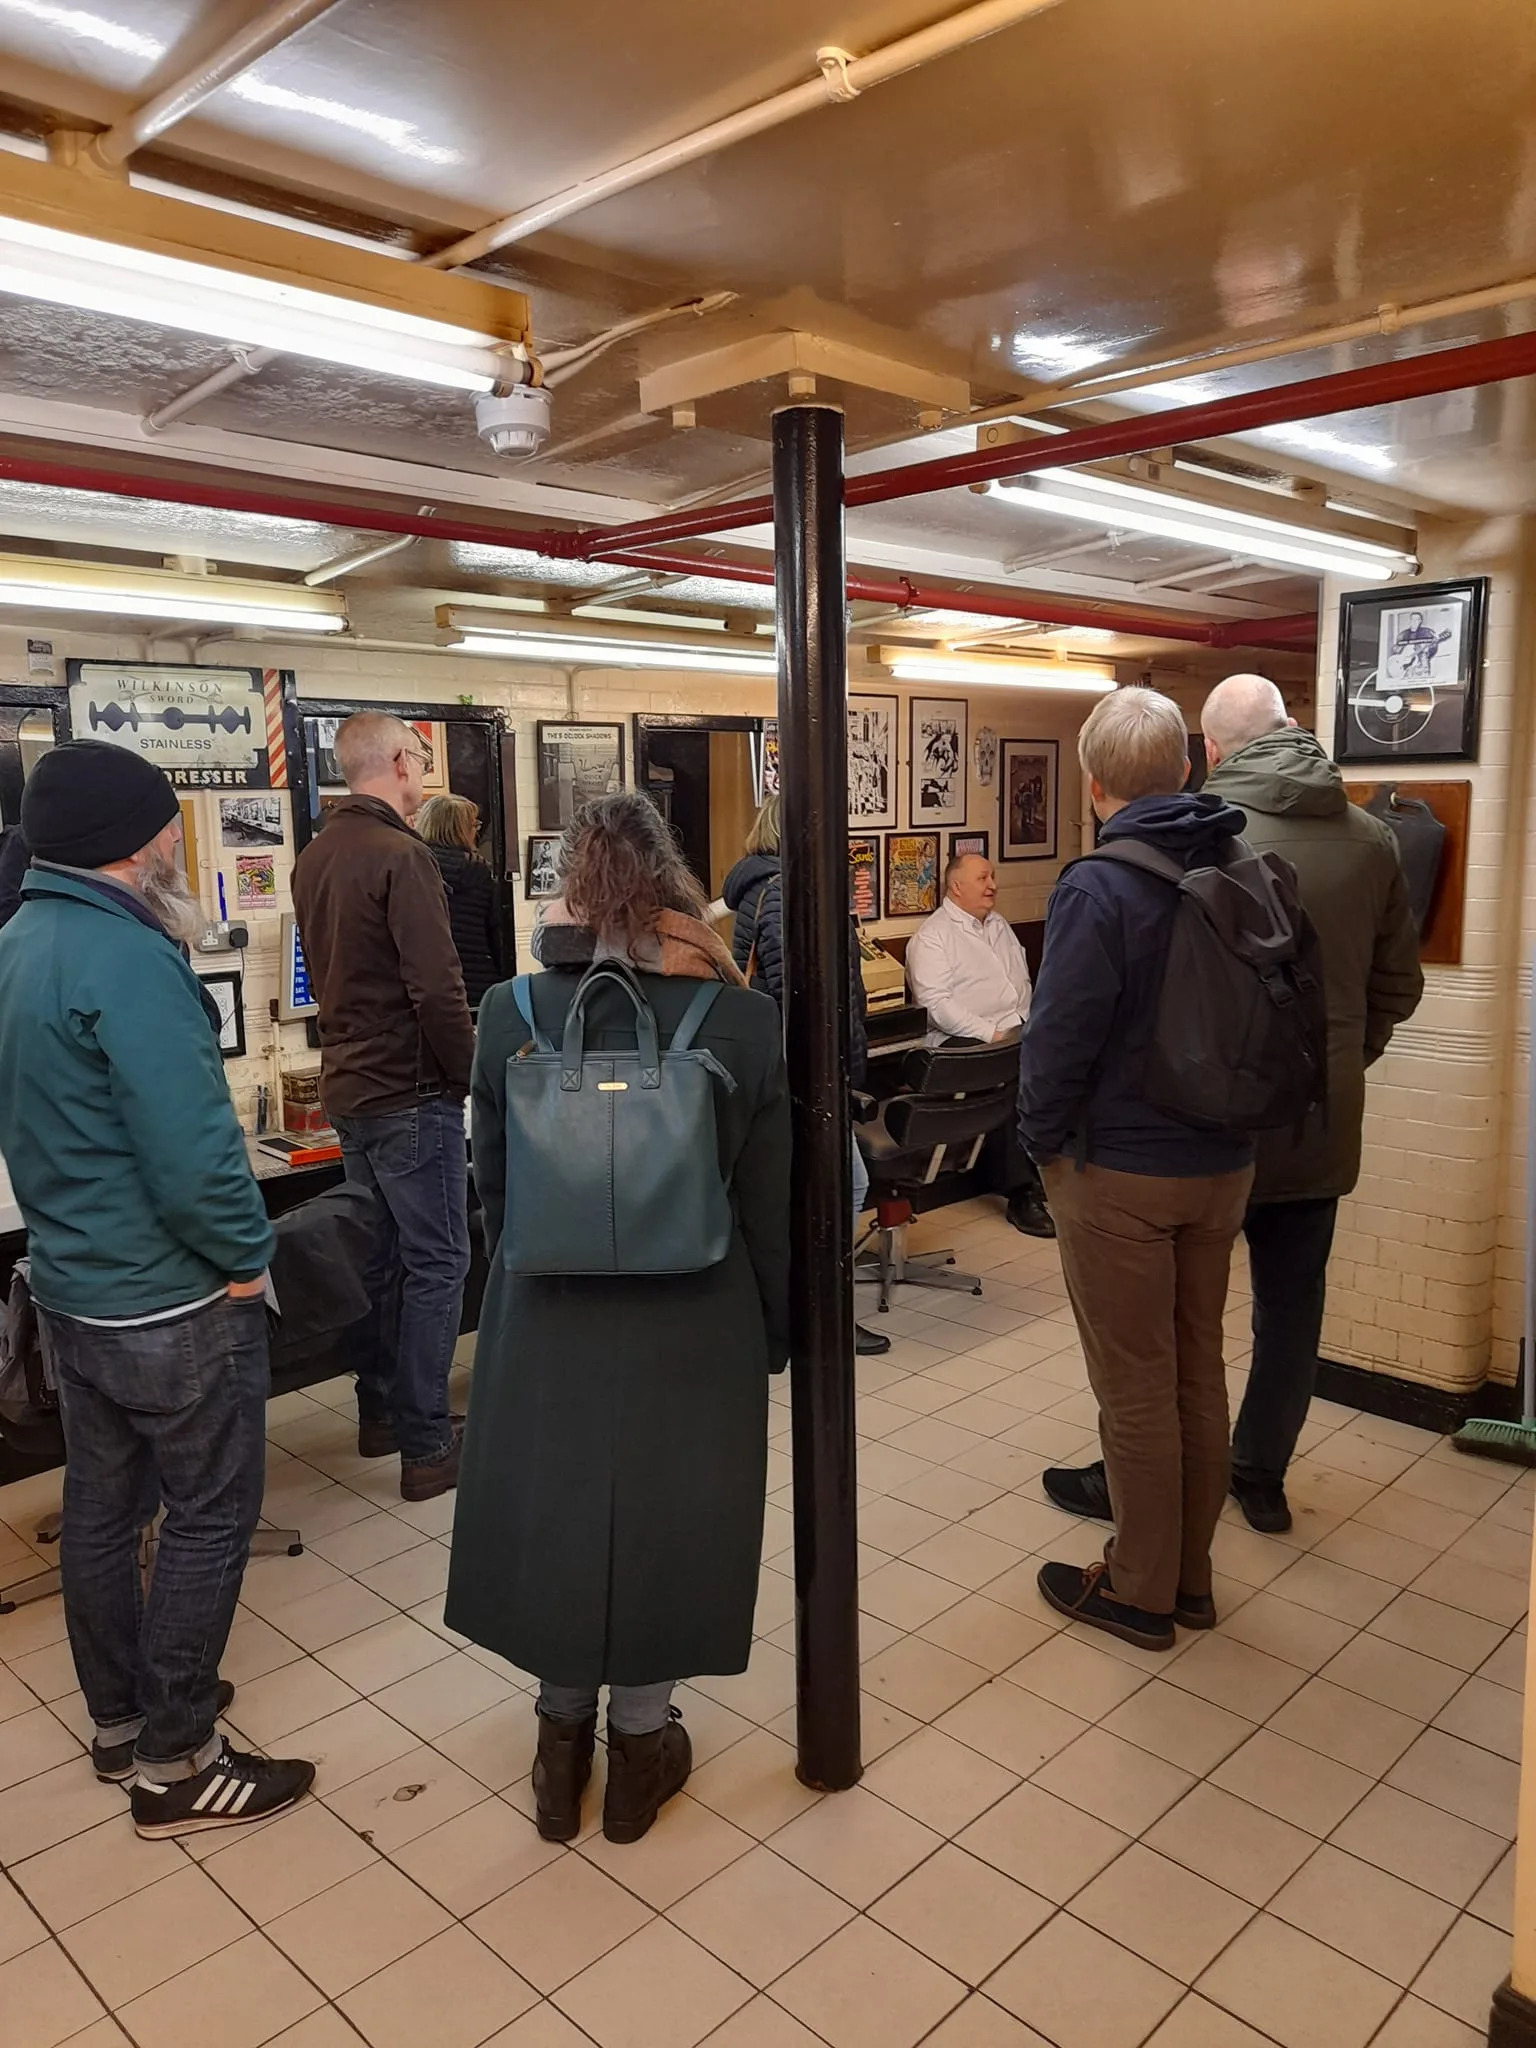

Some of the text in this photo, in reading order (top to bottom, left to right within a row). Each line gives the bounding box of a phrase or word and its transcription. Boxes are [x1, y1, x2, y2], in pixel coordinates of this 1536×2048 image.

[117, 679, 223, 693] WILKINSON
[149, 695, 194, 704] SWORD
[140, 738, 212, 749] STAINLESS
